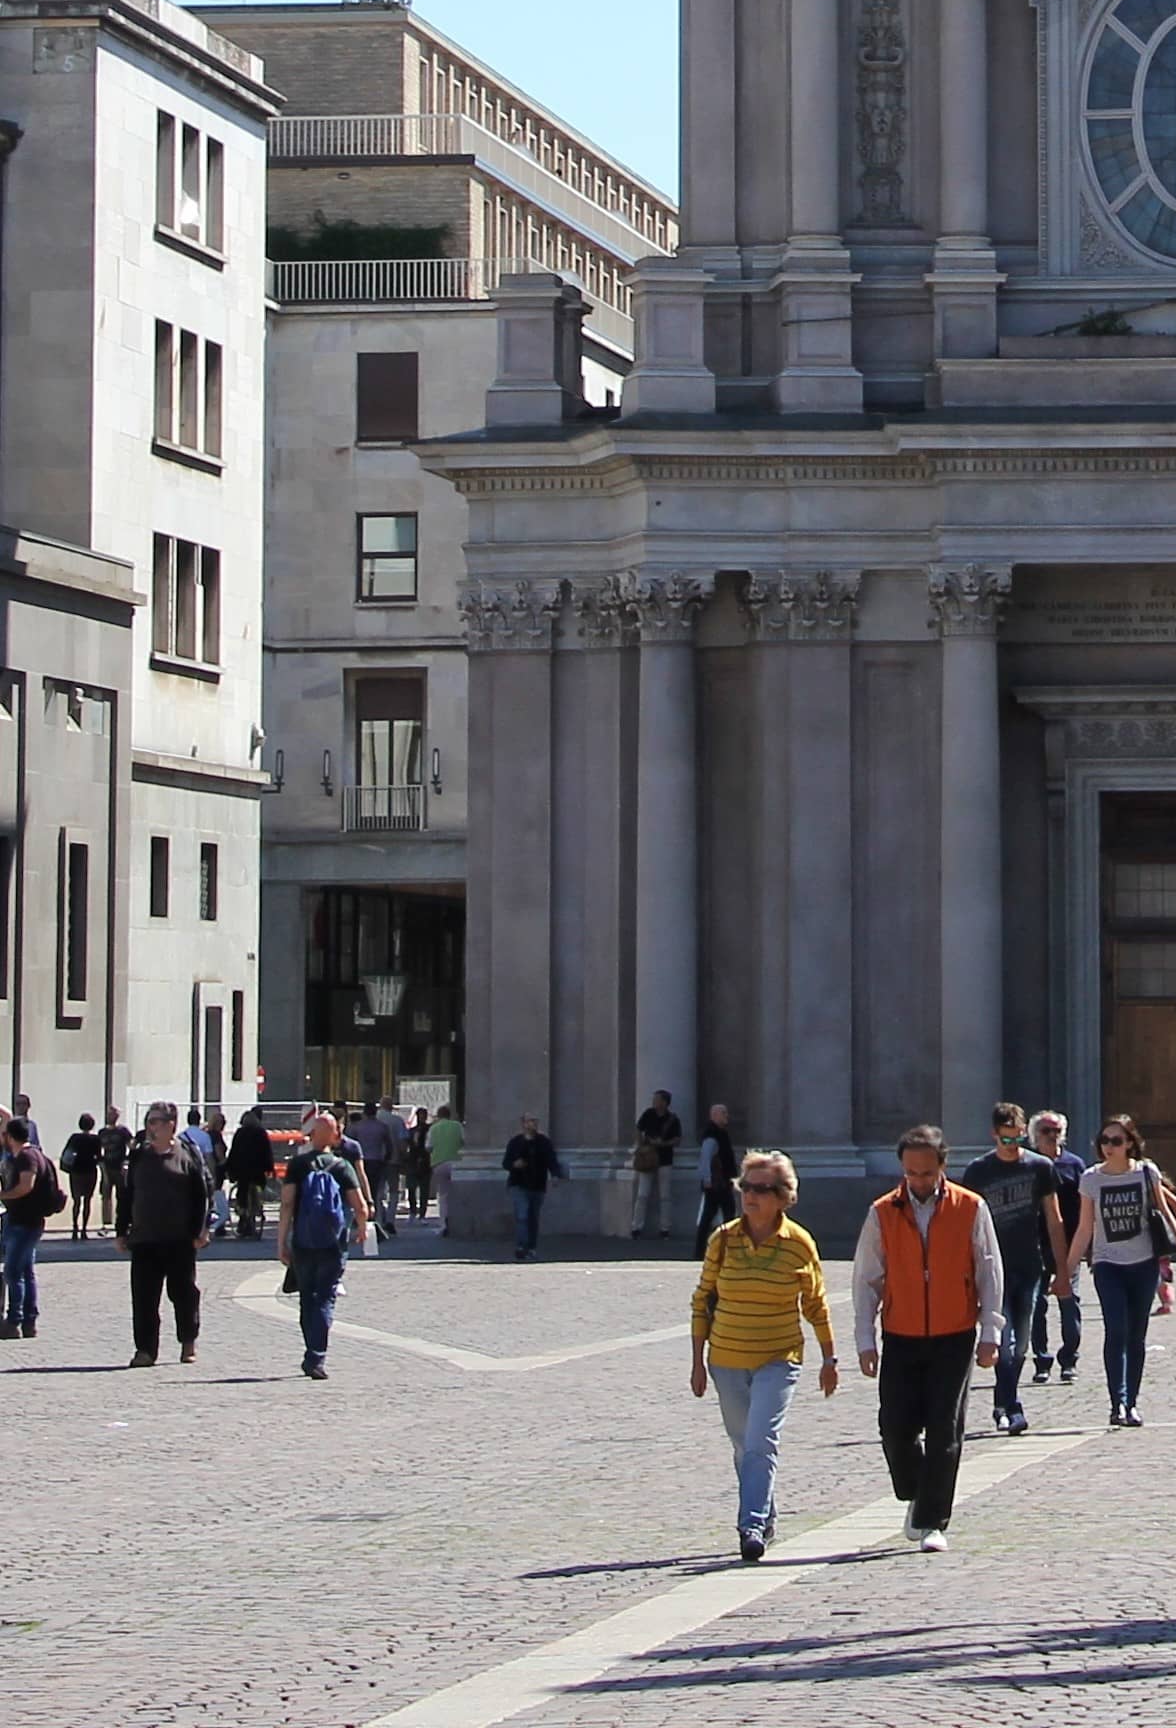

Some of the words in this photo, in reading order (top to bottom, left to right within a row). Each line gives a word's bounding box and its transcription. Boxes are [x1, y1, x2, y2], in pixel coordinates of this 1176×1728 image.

[1105, 1191, 1137, 1205] HAVE
[1103, 1207, 1111, 1218] A
[1112, 1205, 1140, 1217] NICE
